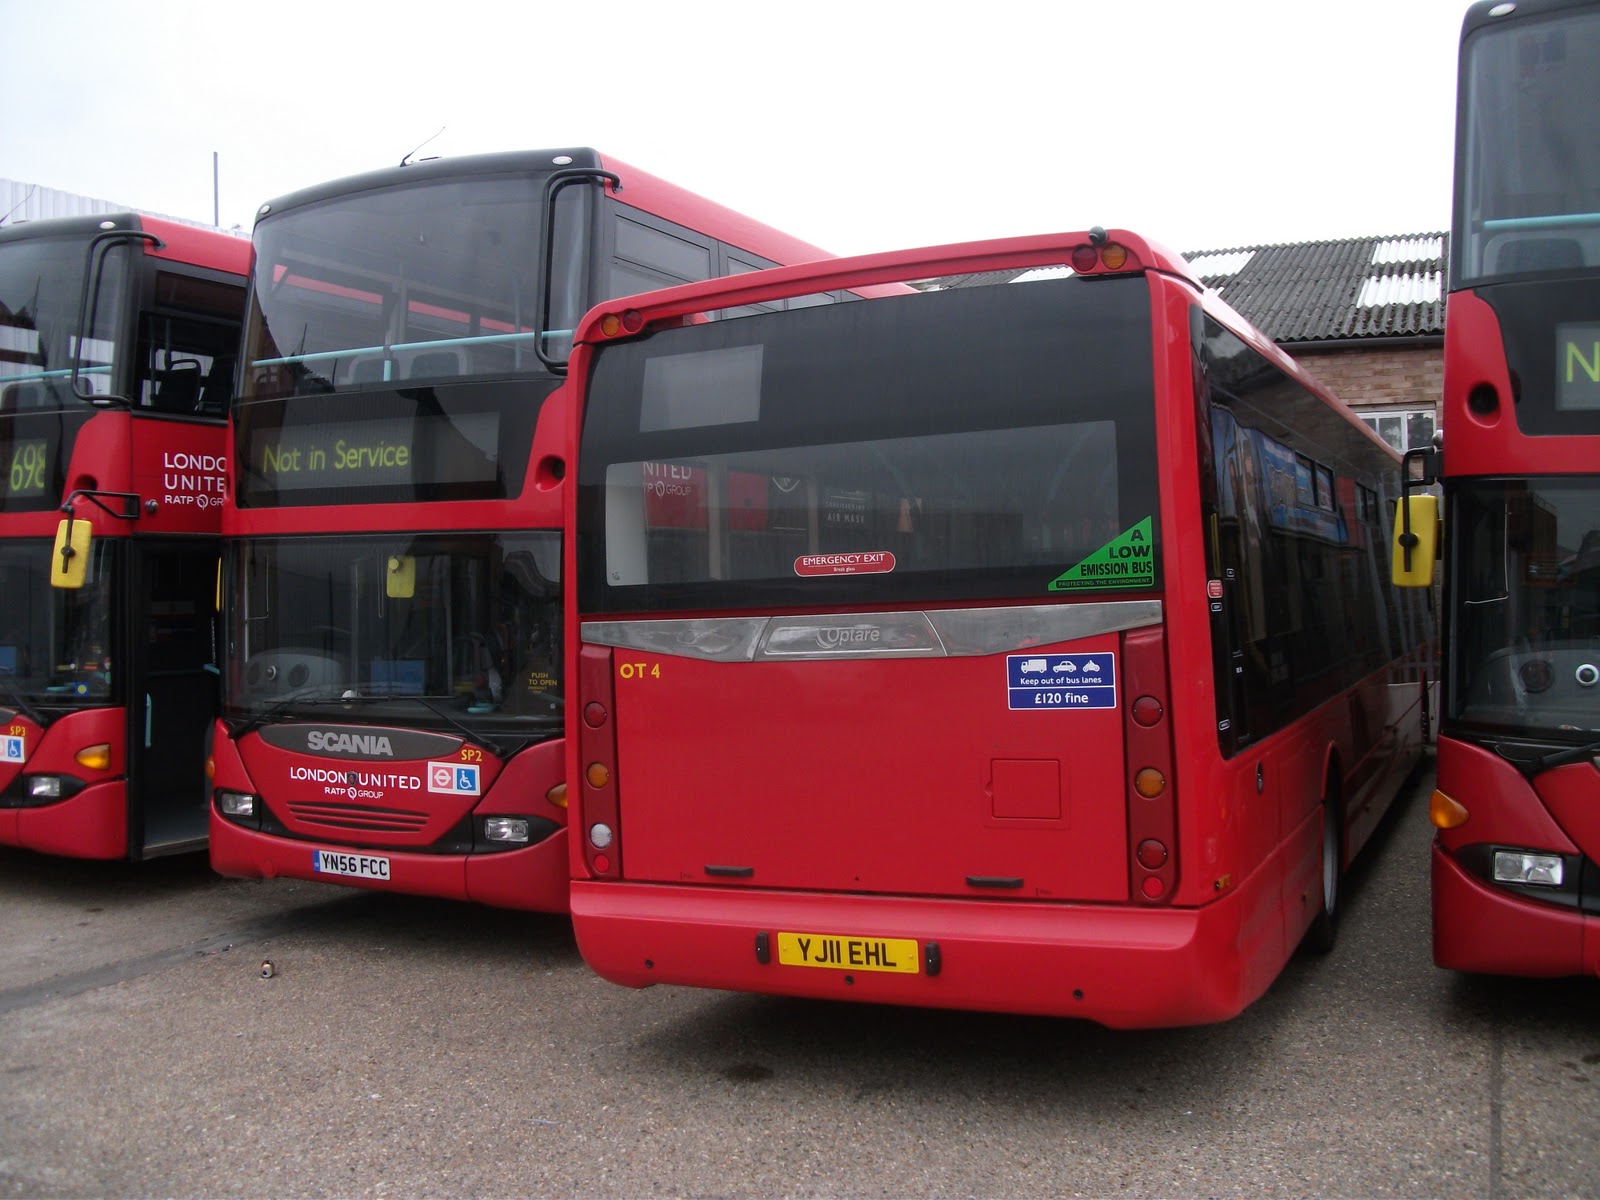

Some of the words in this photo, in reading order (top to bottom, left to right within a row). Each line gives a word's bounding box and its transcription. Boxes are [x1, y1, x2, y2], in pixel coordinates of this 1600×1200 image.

[263, 444, 300, 472] Not
[309, 446, 325, 470] in
[335, 440, 408, 469] Service
[164, 473, 224, 492] UNITE
[164, 494, 194, 505] RATP
[1130, 529, 1145, 542] A
[1108, 545, 1151, 559] LOW
[802, 555, 861, 567] EMERGENCY
[863, 553, 885, 563] EXIT
[1080, 562, 1129, 577] EMISSION
[1131, 561, 1153, 574] BUS
[816, 628, 880, 649] Optare
[620, 663, 647, 679] OT
[651, 663, 660, 679] 4
[529, 678, 538, 686] TO
[1020, 678, 1039, 686] Keep
[1067, 676, 1080, 684] bus
[1034, 693, 1062, 704] £120
[1065, 692, 1089, 703] fine
[10, 725, 26, 737] SP3
[307, 731, 393, 756] SCANIA
[461, 749, 482, 762] SP2
[290, 766, 348, 784] LONDON
[358, 775, 421, 790] UNITED
[324, 786, 346, 796] RATP
[357, 788, 384, 799] GROUP
[322, 853, 357, 873] YN56
[360, 858, 388, 876] FCC
[797, 937, 842, 964] YJ11
[848, 941, 897, 967] EHL
